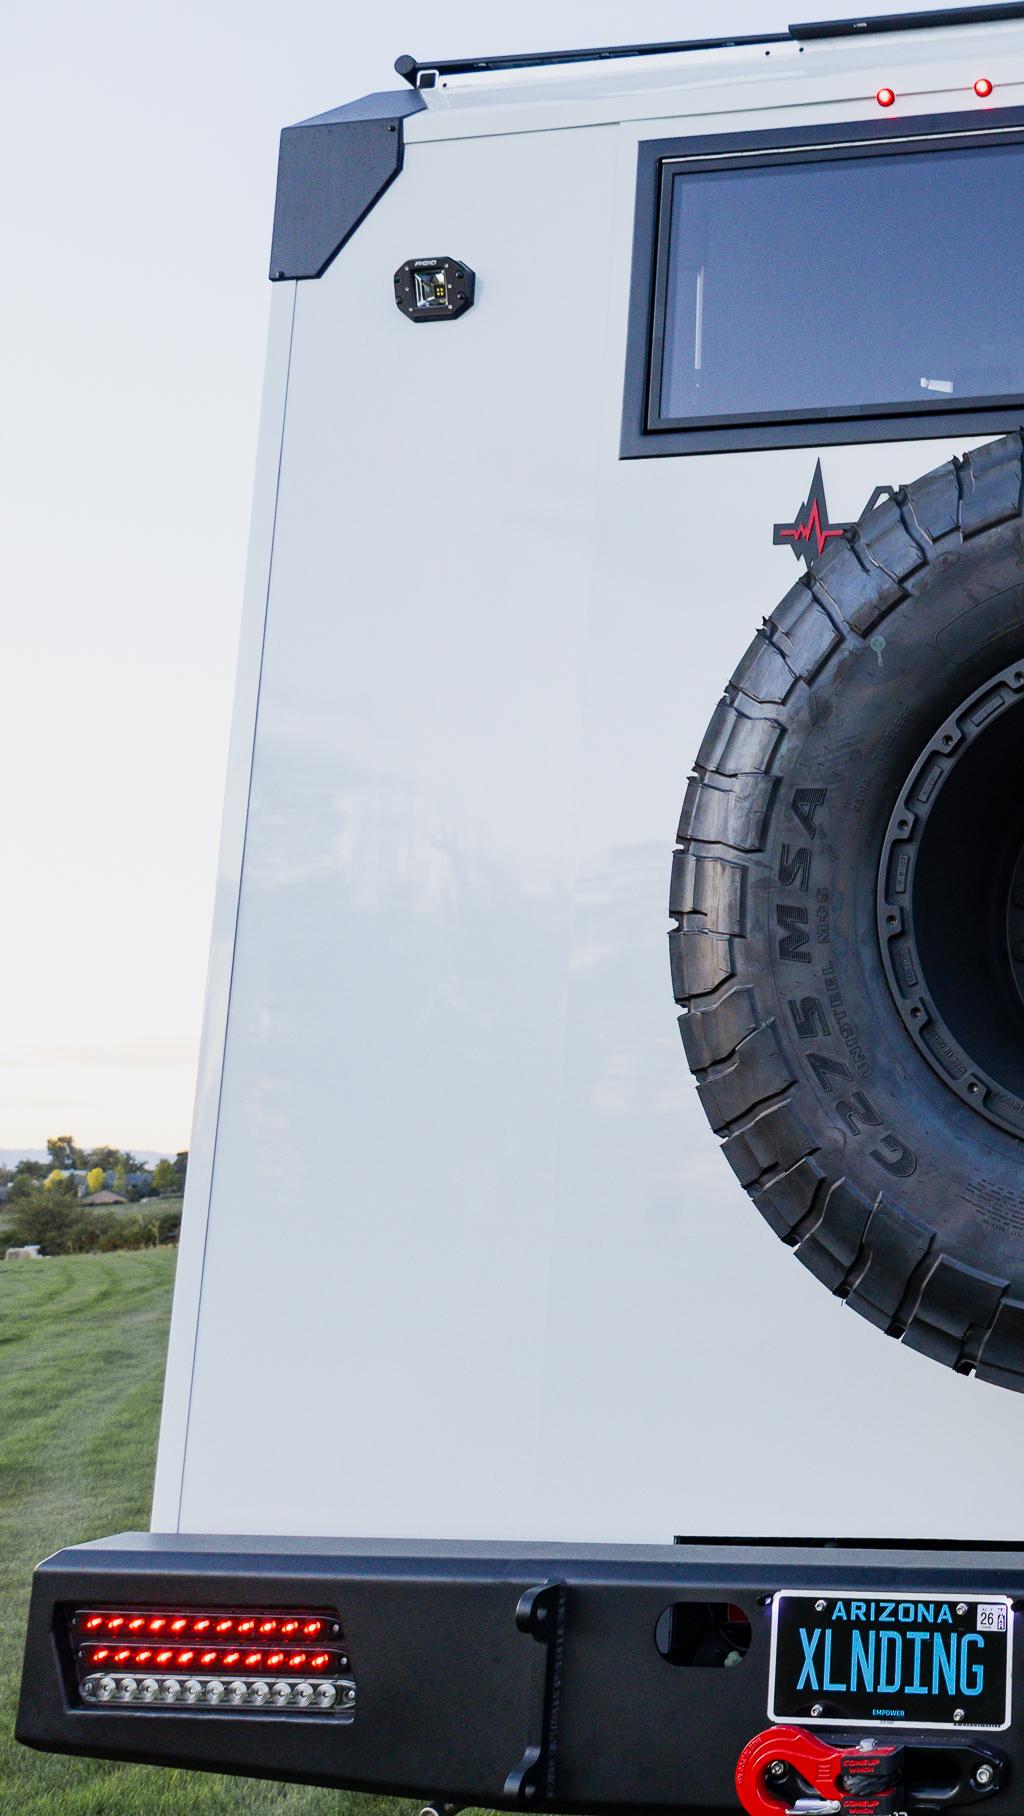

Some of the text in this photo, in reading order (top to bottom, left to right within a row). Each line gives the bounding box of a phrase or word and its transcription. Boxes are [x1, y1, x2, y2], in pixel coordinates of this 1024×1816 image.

[776, 787, 918, 1178] G275 MSA
[822, 960, 874, 1080] UNISTEEL
[831, 1600, 953, 1623] ARIZONA
[980, 1611, 994, 1626] 26
[796, 1627, 985, 1696] XLNDING
[872, 1709, 905, 1717] EMPOWER
[843, 1759, 880, 1767] COMEUP
[843, 1800, 880, 1808] COMEUP
